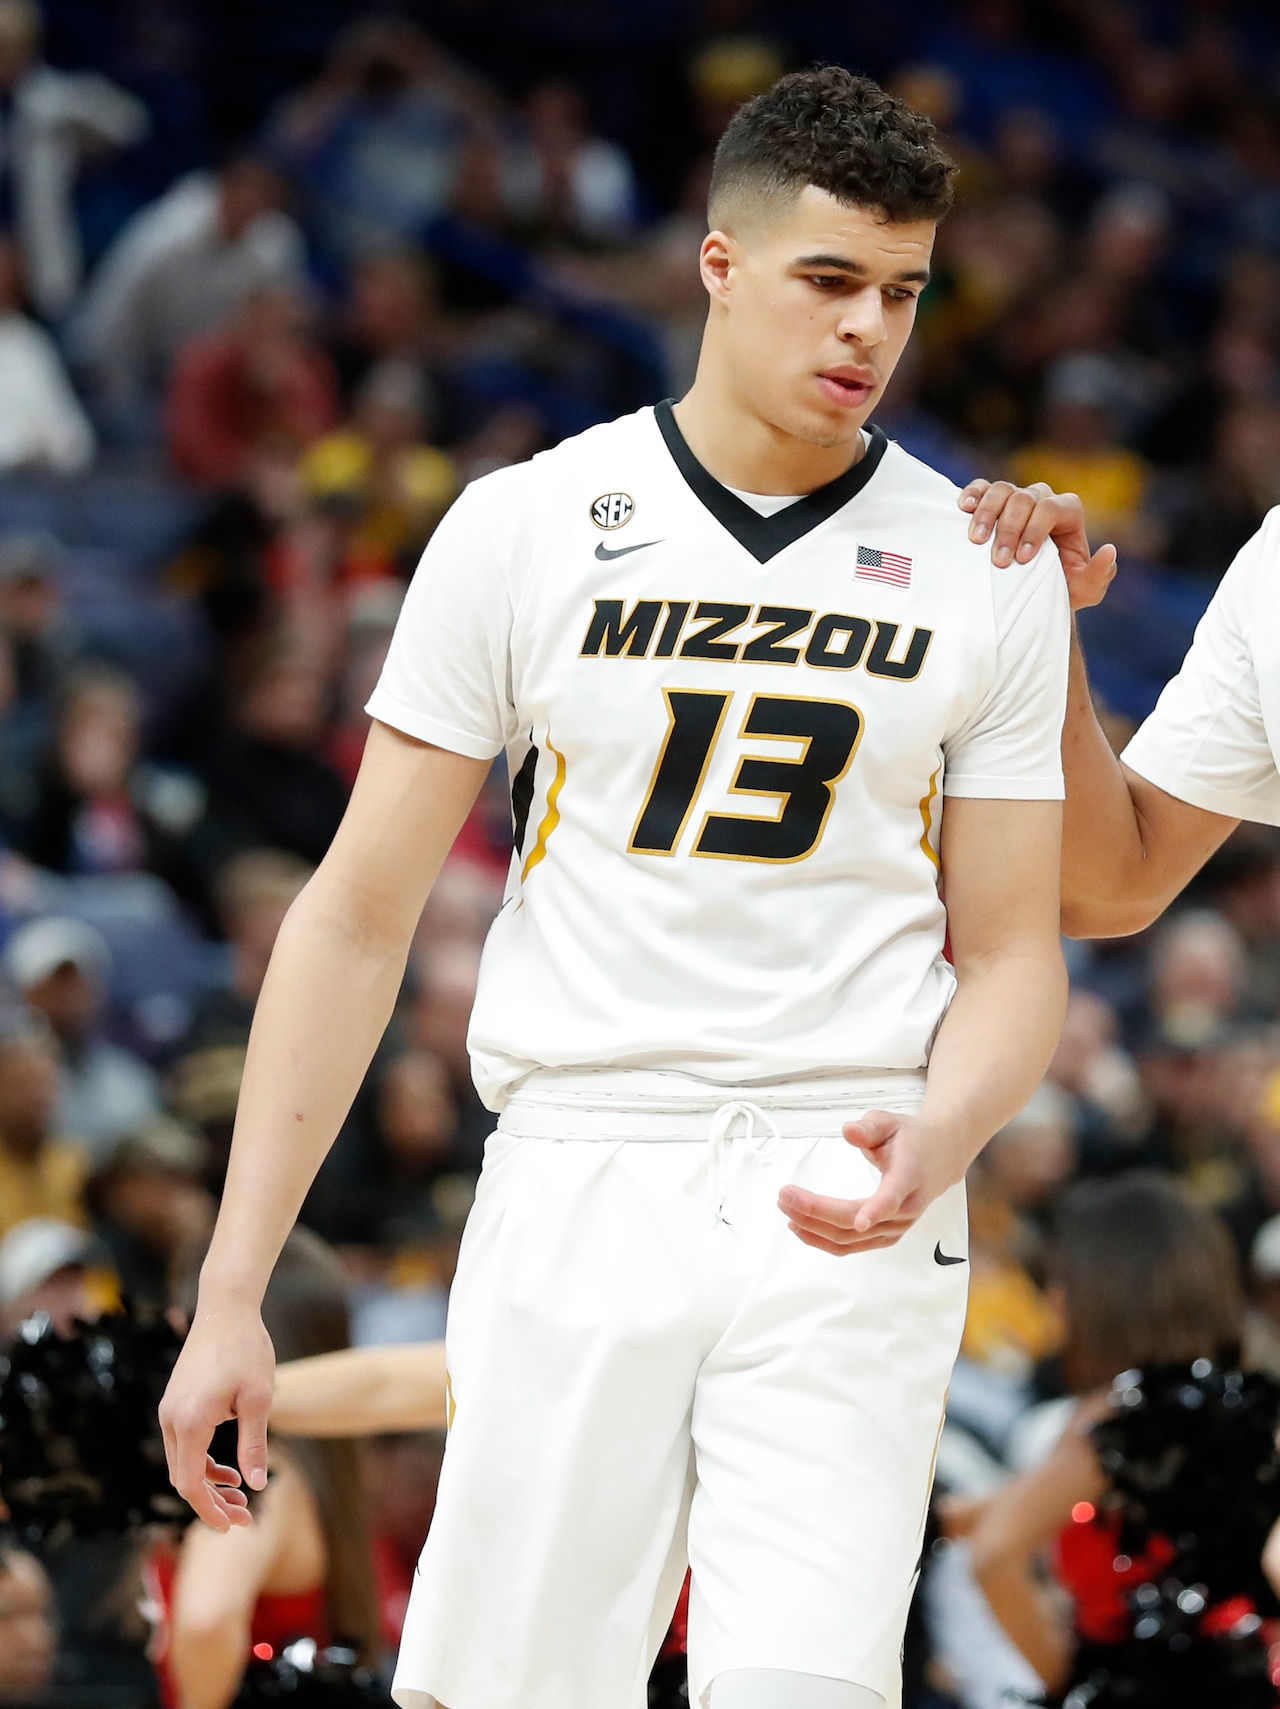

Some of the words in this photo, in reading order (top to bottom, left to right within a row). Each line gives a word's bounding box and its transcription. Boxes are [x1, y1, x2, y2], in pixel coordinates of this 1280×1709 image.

[591, 493, 633, 528] SEC
[577, 598, 935, 682] MIZZOU
[626, 687, 864, 865] 13
